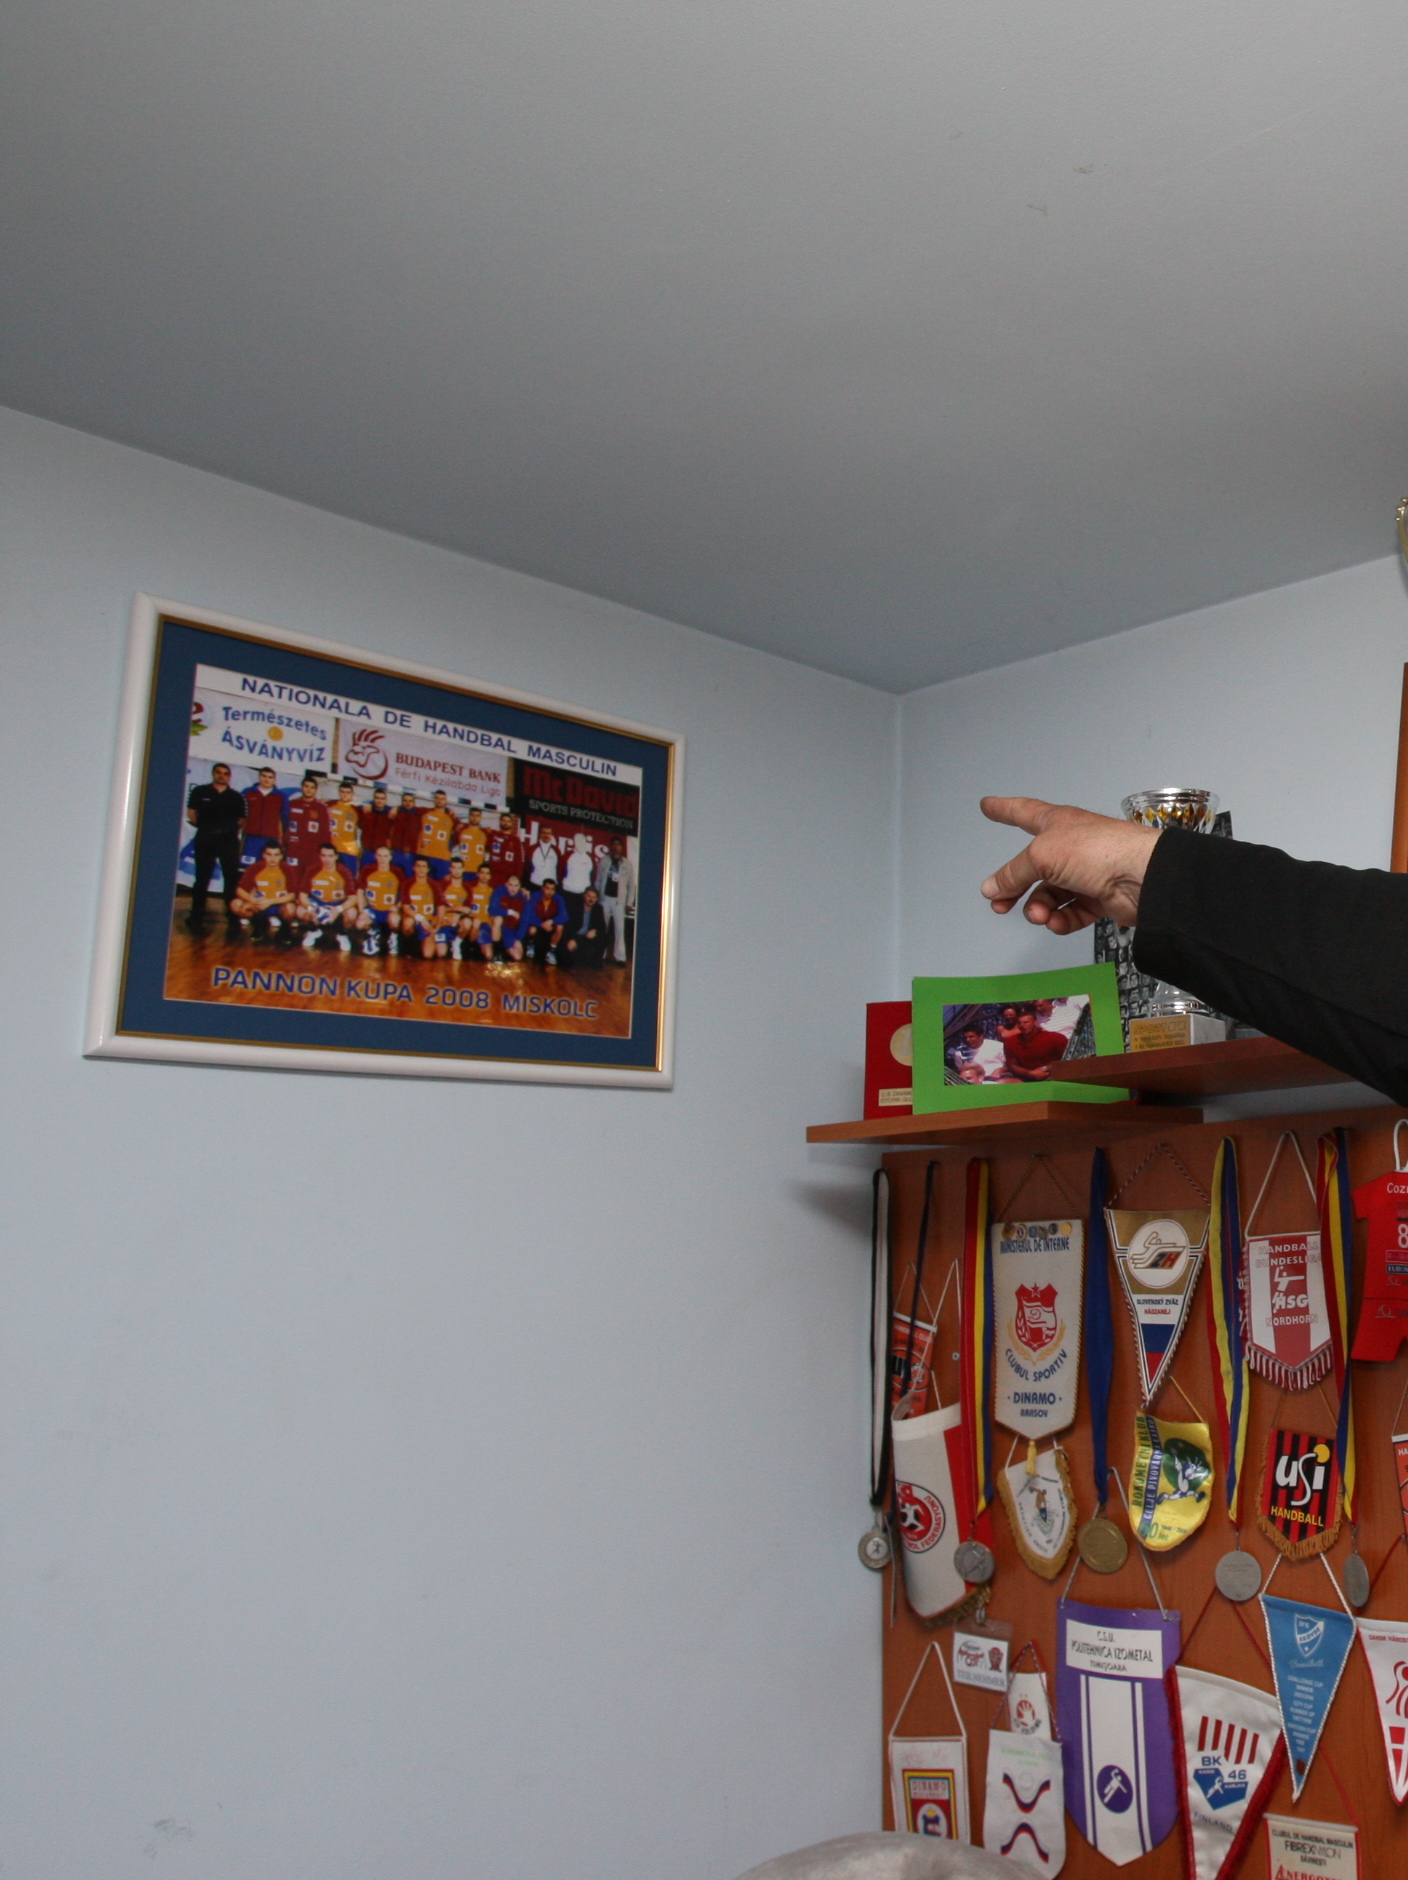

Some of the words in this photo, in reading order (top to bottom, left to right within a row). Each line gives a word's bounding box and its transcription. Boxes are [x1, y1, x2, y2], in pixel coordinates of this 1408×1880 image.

[222, 706, 327, 740] Természetes
[241, 677, 372, 719] NATIONALA
[384, 710, 412, 729] DE
[423, 720, 517, 753] HANDBAL
[527, 745, 617, 777] MASCULIN
[221, 726, 327, 763] ÁSVÁNYVÍZ
[395, 752, 465, 778] BUDAPEST
[468, 767, 501, 784] BANK
[528, 799, 569, 816] SPORTS
[570, 807, 634, 829] PROTECTION
[213, 966, 338, 996] PANNON
[346, 979, 413, 1003] KUPA
[425, 986, 489, 1009] 2008
[502, 994, 598, 1018] MISKOLC
[1275, 1293, 1309, 1310] HSG
[1265, 1313, 1319, 1327] NORDHORN
[1005, 1348, 1029, 1381] CLUBUL
[1033, 1348, 1067, 1381] SPORTIV
[1013, 1391, 1056, 1405] DINAMO
[1271, 1505, 1324, 1527] HANDBALL
[1114, 1646, 1153, 1662] IZOMETAL
[1201, 1756, 1221, 1766] BK
[912, 1780, 946, 1791] DINAMO
[1228, 1769, 1247, 1780] 46
[1194, 1811, 1233, 1833] FINLAND
